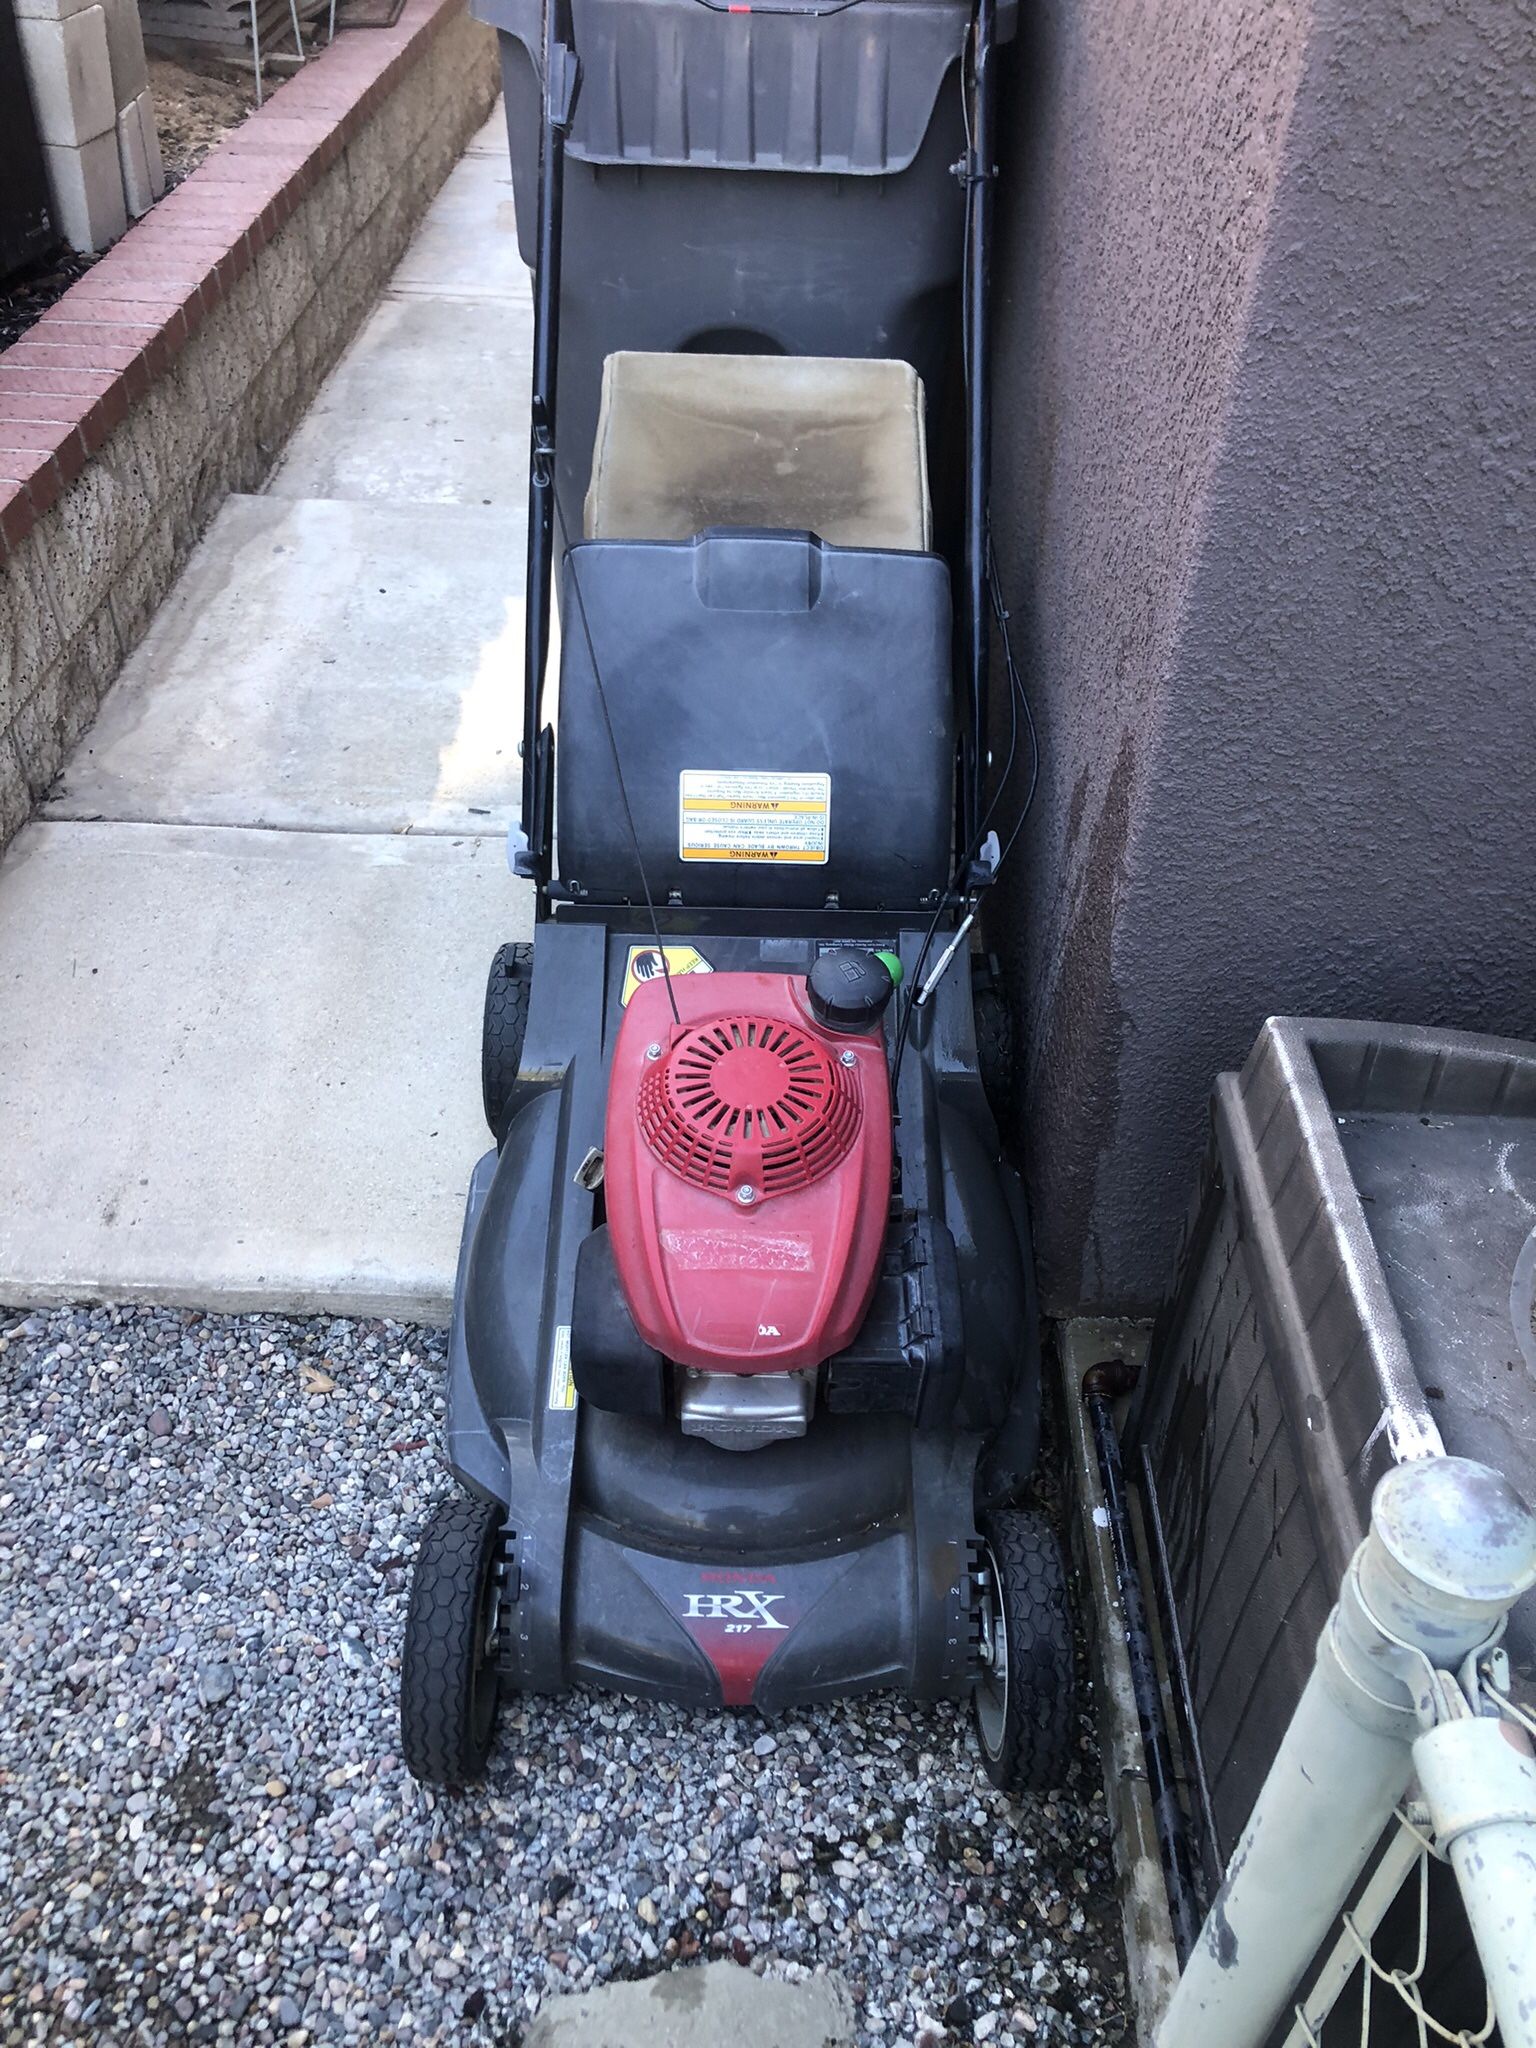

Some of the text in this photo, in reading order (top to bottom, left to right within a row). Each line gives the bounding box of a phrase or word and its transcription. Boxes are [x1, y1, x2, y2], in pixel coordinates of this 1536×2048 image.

[692, 1424, 797, 1433] HONDA
[520, 1583, 529, 1591] 2
[951, 1587, 960, 1595] 2
[682, 1590, 789, 1629] HRX
[724, 1624, 752, 1633] 217
[520, 1633, 529, 1641] 3
